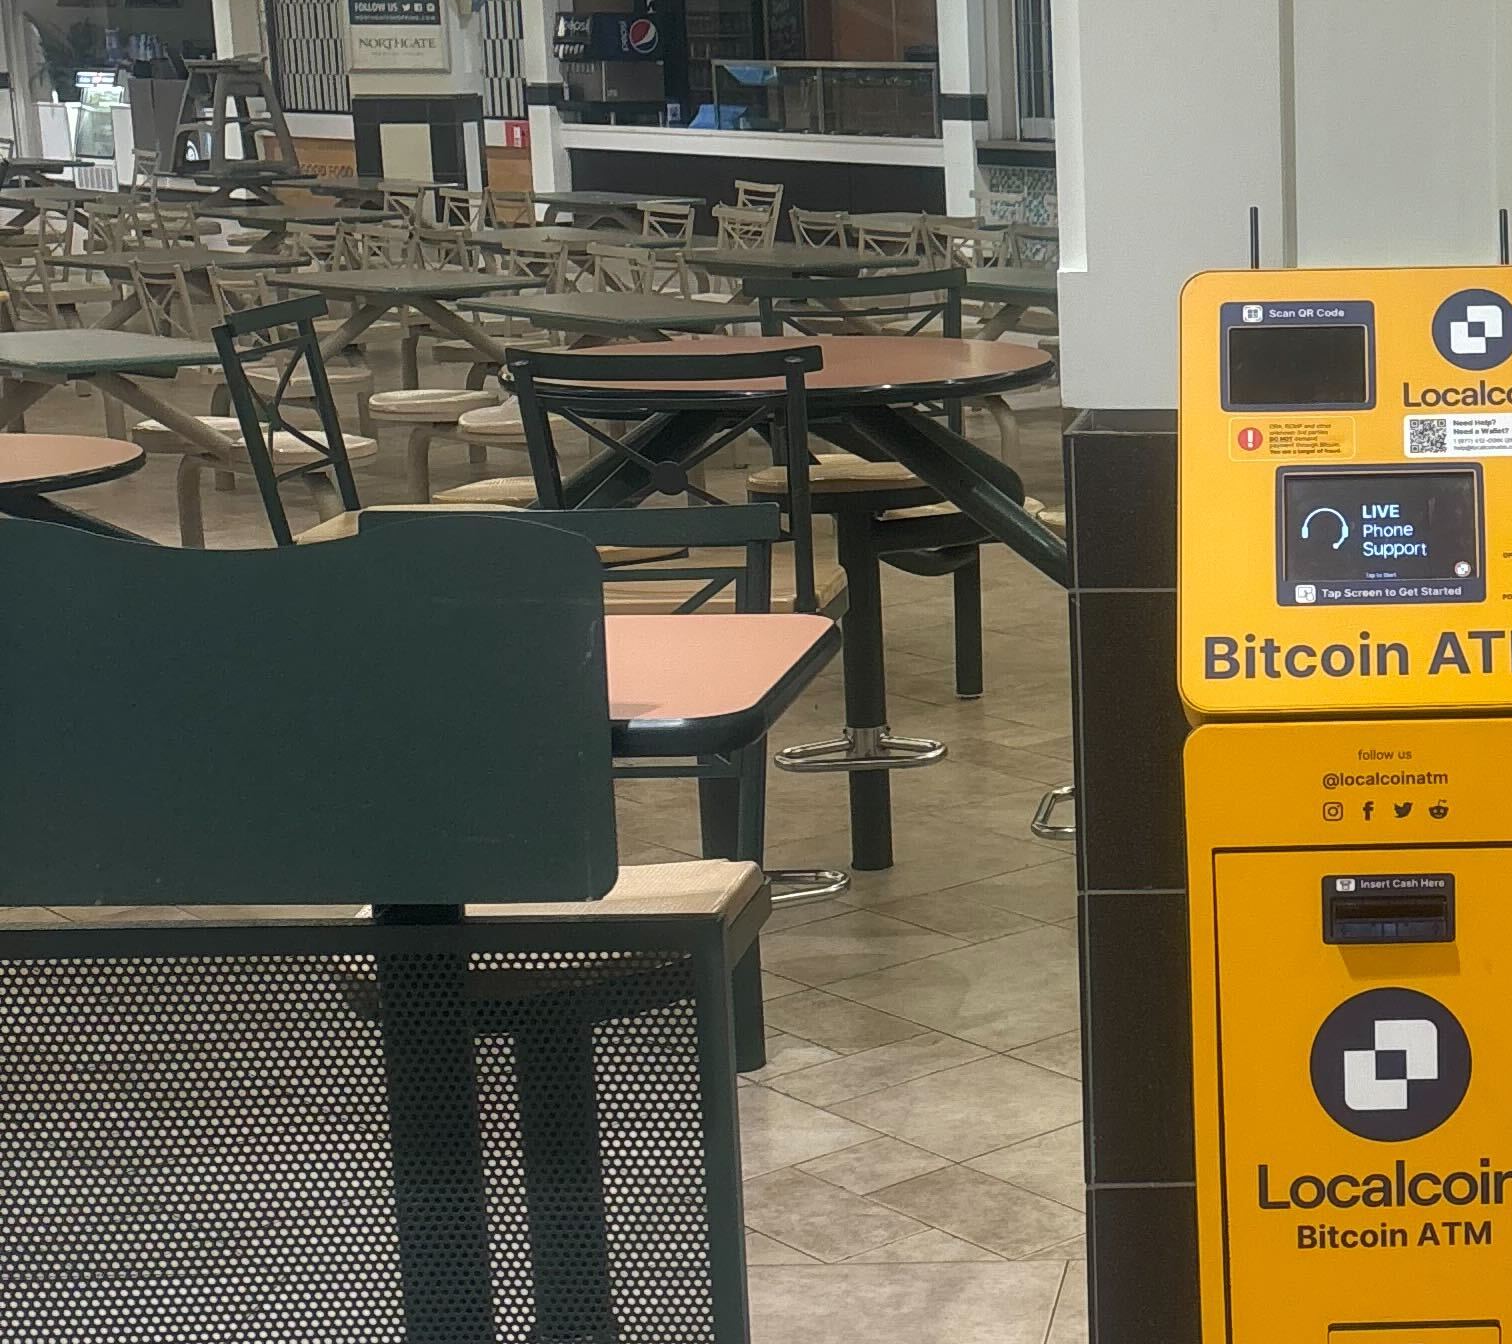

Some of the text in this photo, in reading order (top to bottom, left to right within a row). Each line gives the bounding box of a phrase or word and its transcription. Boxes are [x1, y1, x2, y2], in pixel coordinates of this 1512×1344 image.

[354, 2, 398, 12] FOLLOW US
[359, 38, 437, 49] NORTHGATE
[1269, 308, 1345, 318] Scan QR Code
[1475, 419, 1497, 427] Help?
[1362, 504, 1400, 519] LIVE
[1362, 523, 1414, 538] Phone
[1362, 542, 1428, 559] Support
[1322, 586, 1462, 599] Tap Screen to Get Started
[1204, 632, 1409, 680] Bitcoin
[1357, 749, 1412, 760] follow us
[1322, 770, 1448, 790] @localcoinatm
[1360, 878, 1445, 889] Insert Cash Here
[1297, 1221, 1493, 1249] Bitcoin ATM
